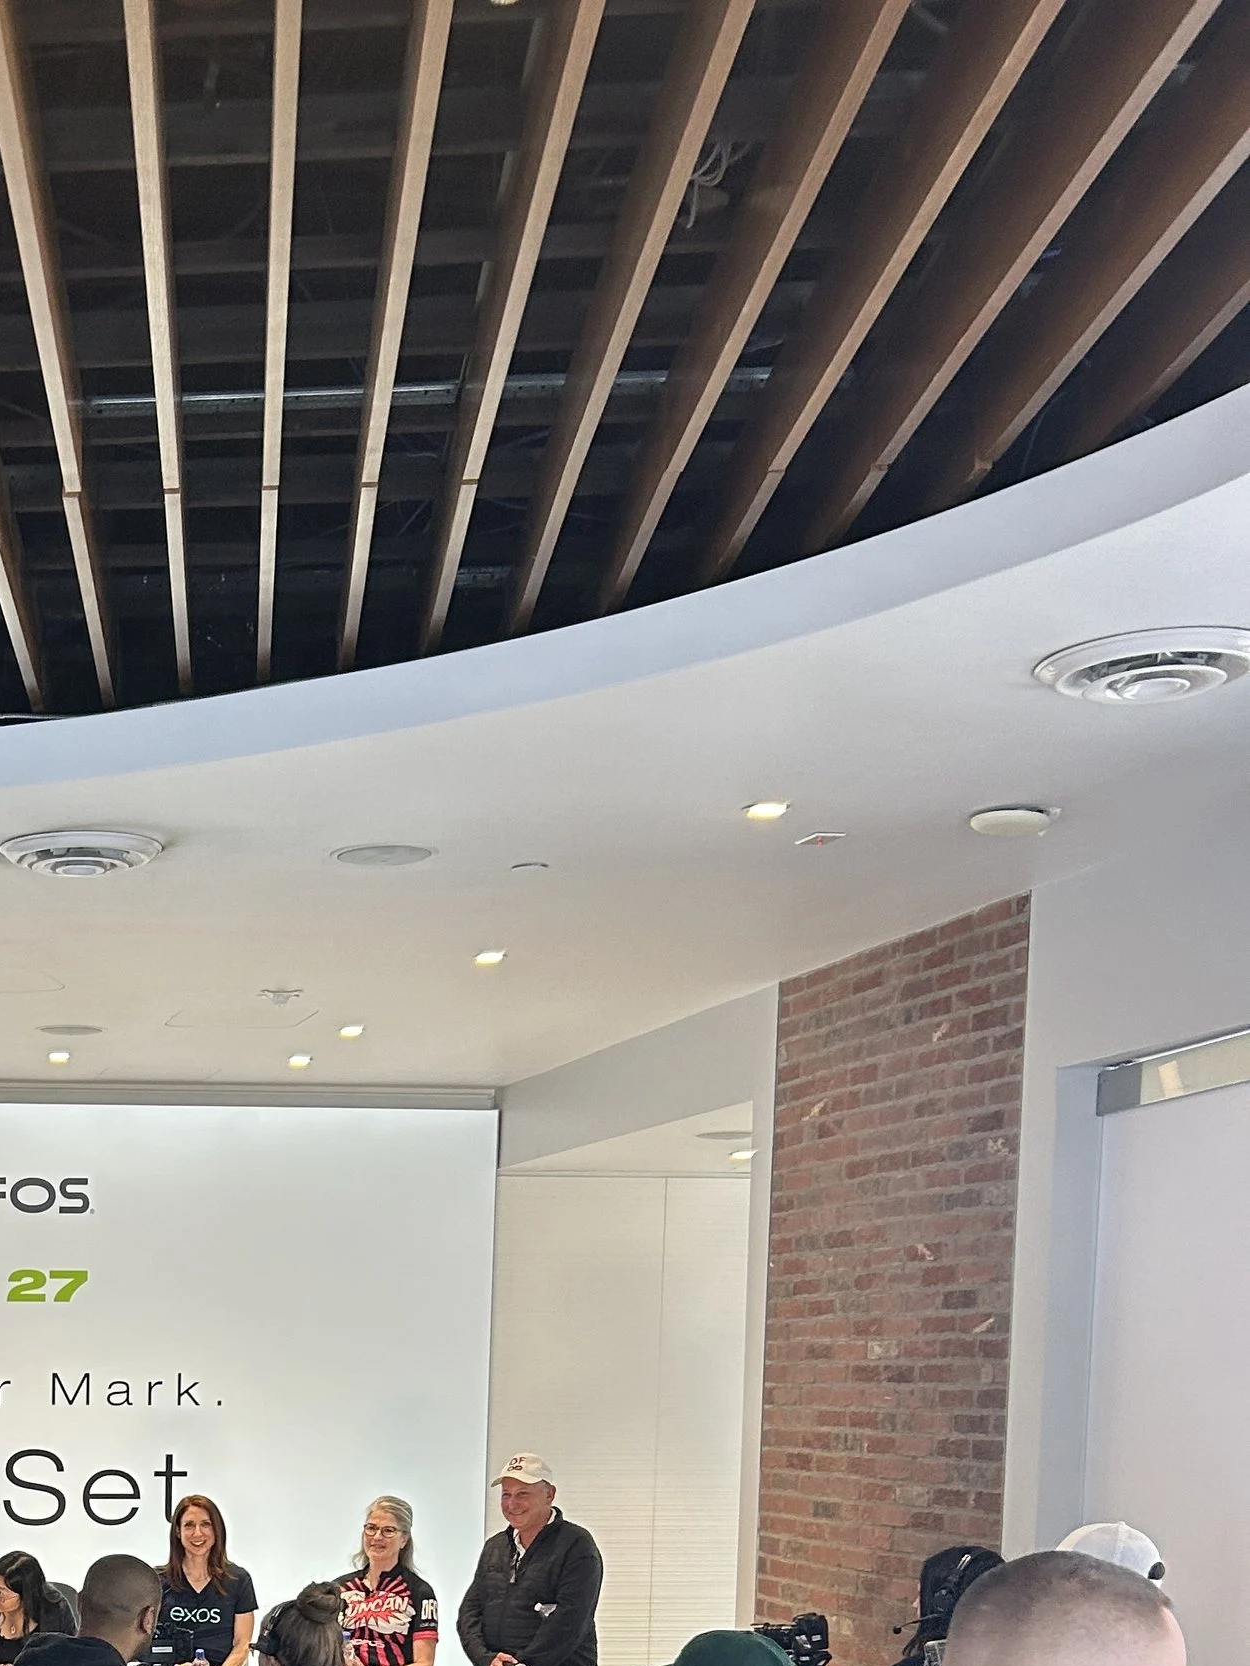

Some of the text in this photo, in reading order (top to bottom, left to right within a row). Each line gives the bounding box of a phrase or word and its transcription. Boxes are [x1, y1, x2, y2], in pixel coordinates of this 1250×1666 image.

[7, 1269, 89, 1303] 27
[51, 1372, 223, 1407] Mark.
[3, 1448, 189, 1527] Set
[170, 1606, 221, 1624] exos
